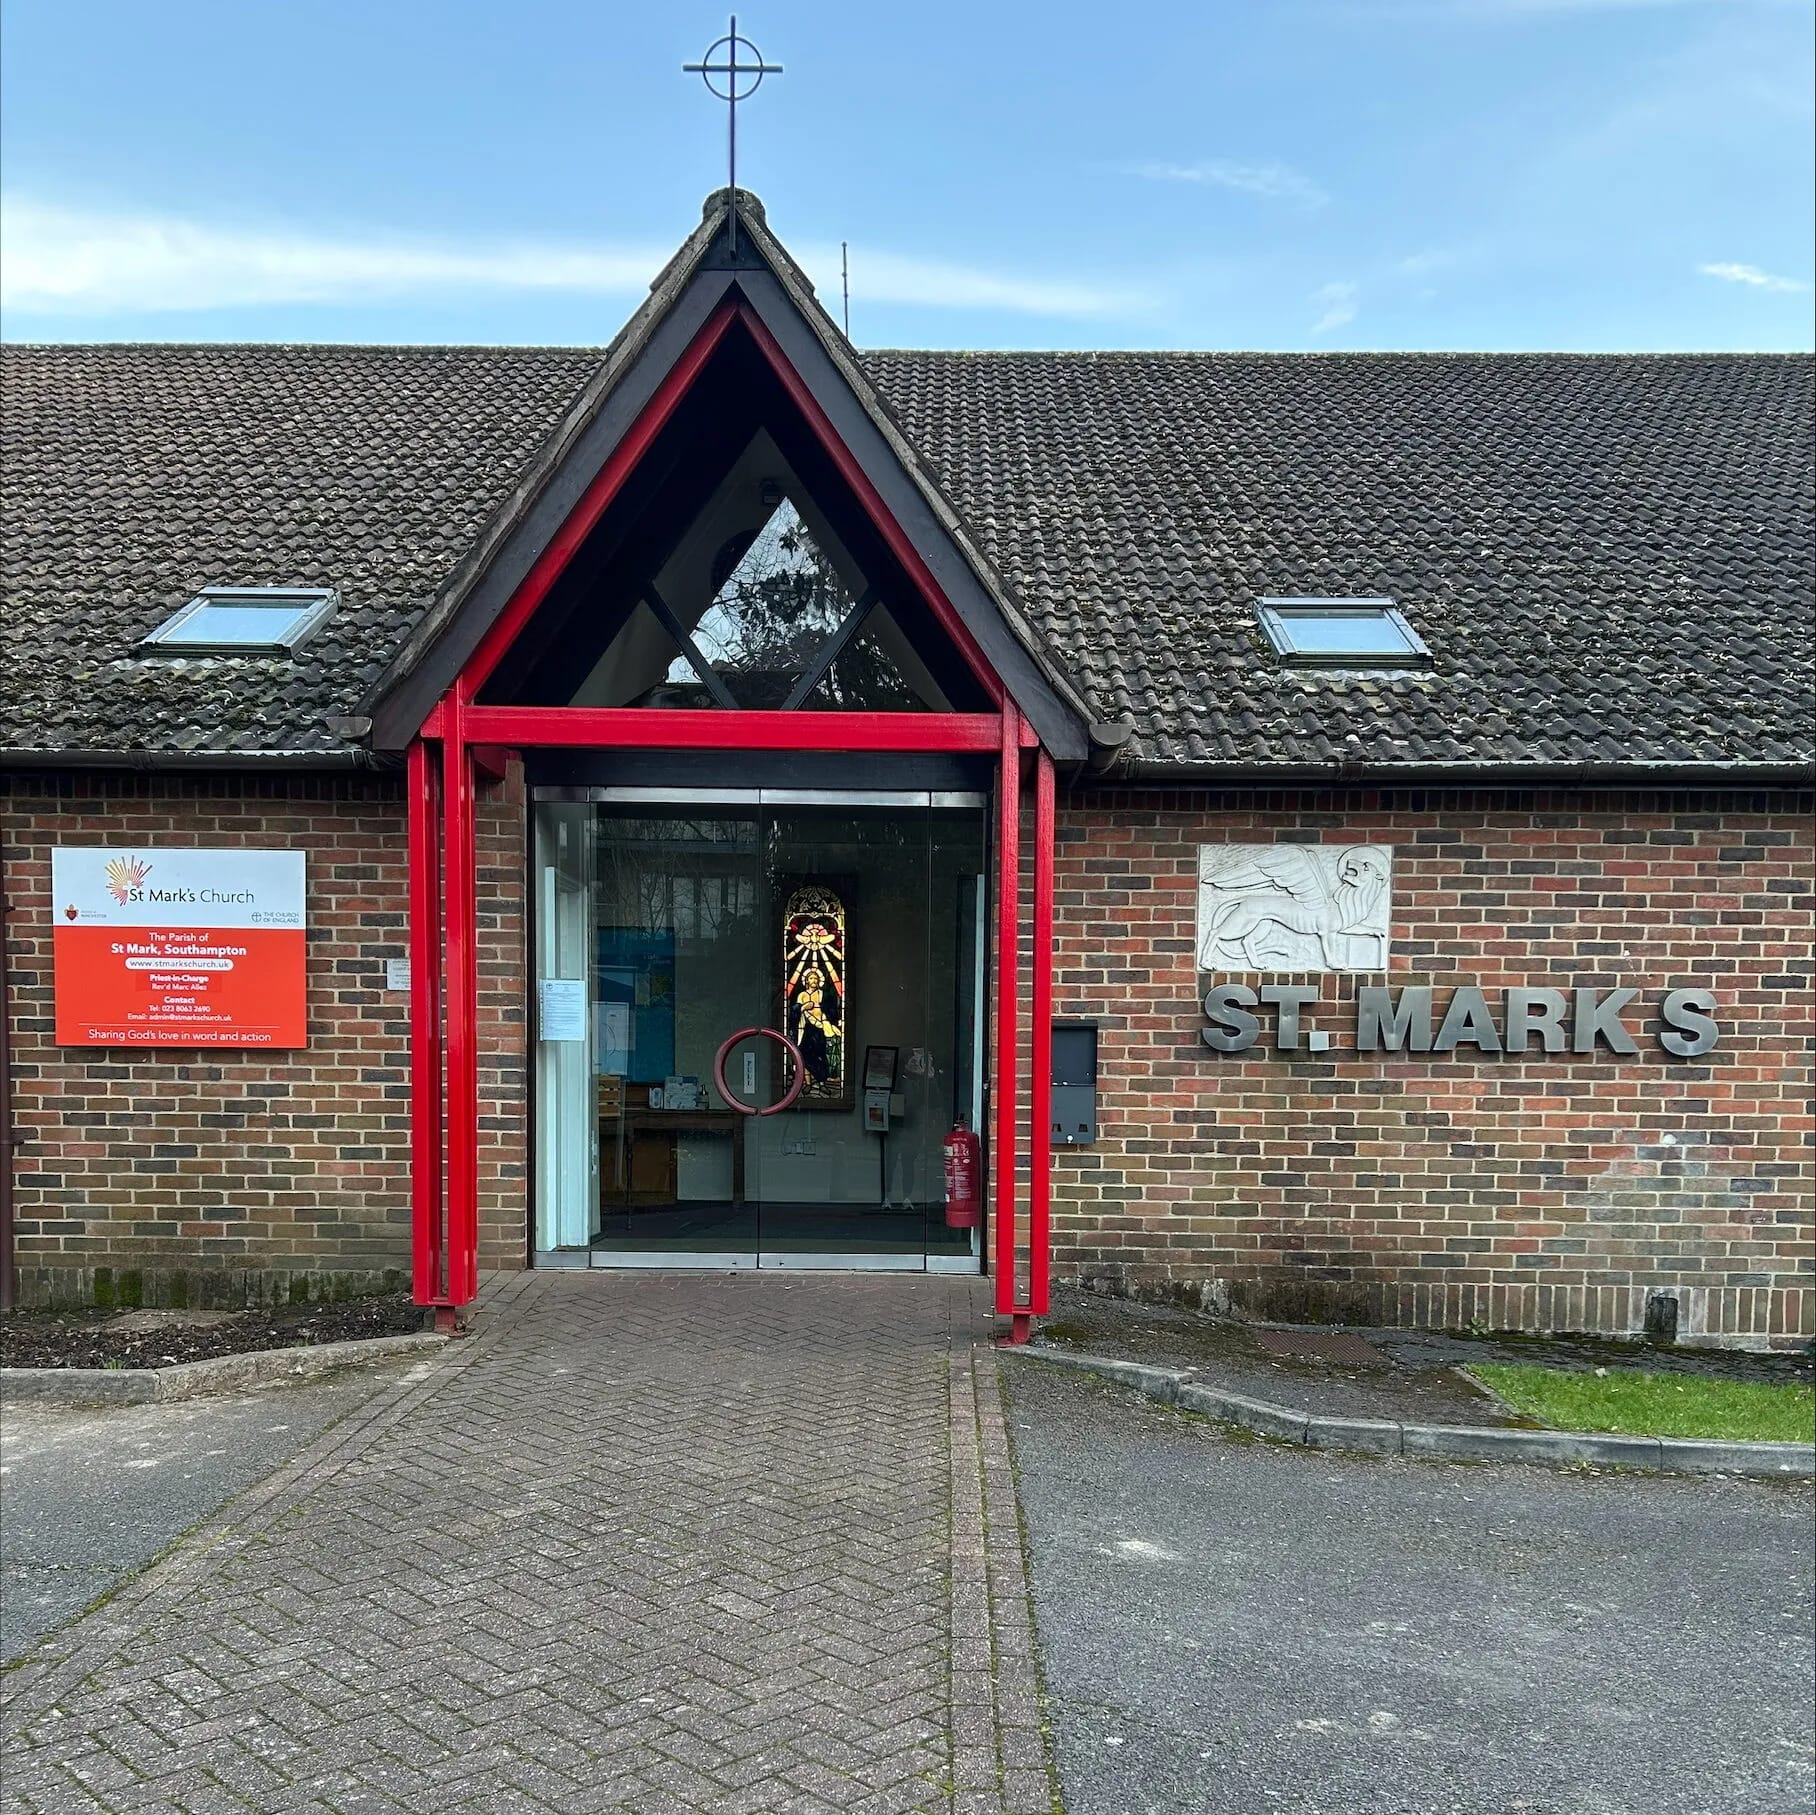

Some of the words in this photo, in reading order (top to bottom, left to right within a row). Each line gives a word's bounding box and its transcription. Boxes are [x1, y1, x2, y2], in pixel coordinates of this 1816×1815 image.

[130, 889, 144, 902] St
[149, 888, 196, 903] Mark's
[200, 889, 255, 903] Church
[149, 932, 166, 942] The
[169, 932, 197, 942] Parish
[199, 932, 209, 942] of
[111, 944, 124, 954] St
[127, 944, 161, 955] Mark,
[164, 944, 247, 958] Southampton
[129, 959, 230, 969] www.stmarkschurch.uk
[149, 974, 209, 984] Priest-in-Charge
[163, 996, 195, 1004] Contact
[1201, 983, 1329, 1052] ST.
[88, 1029, 126, 1041] Sharing
[128, 1029, 156, 1040] God's
[158, 1030, 179, 1040] love
[181, 1030, 191, 1040] in
[192, 1030, 218, 1041] word
[219, 1031, 239, 1041] and
[241, 1031, 271, 1042] action
